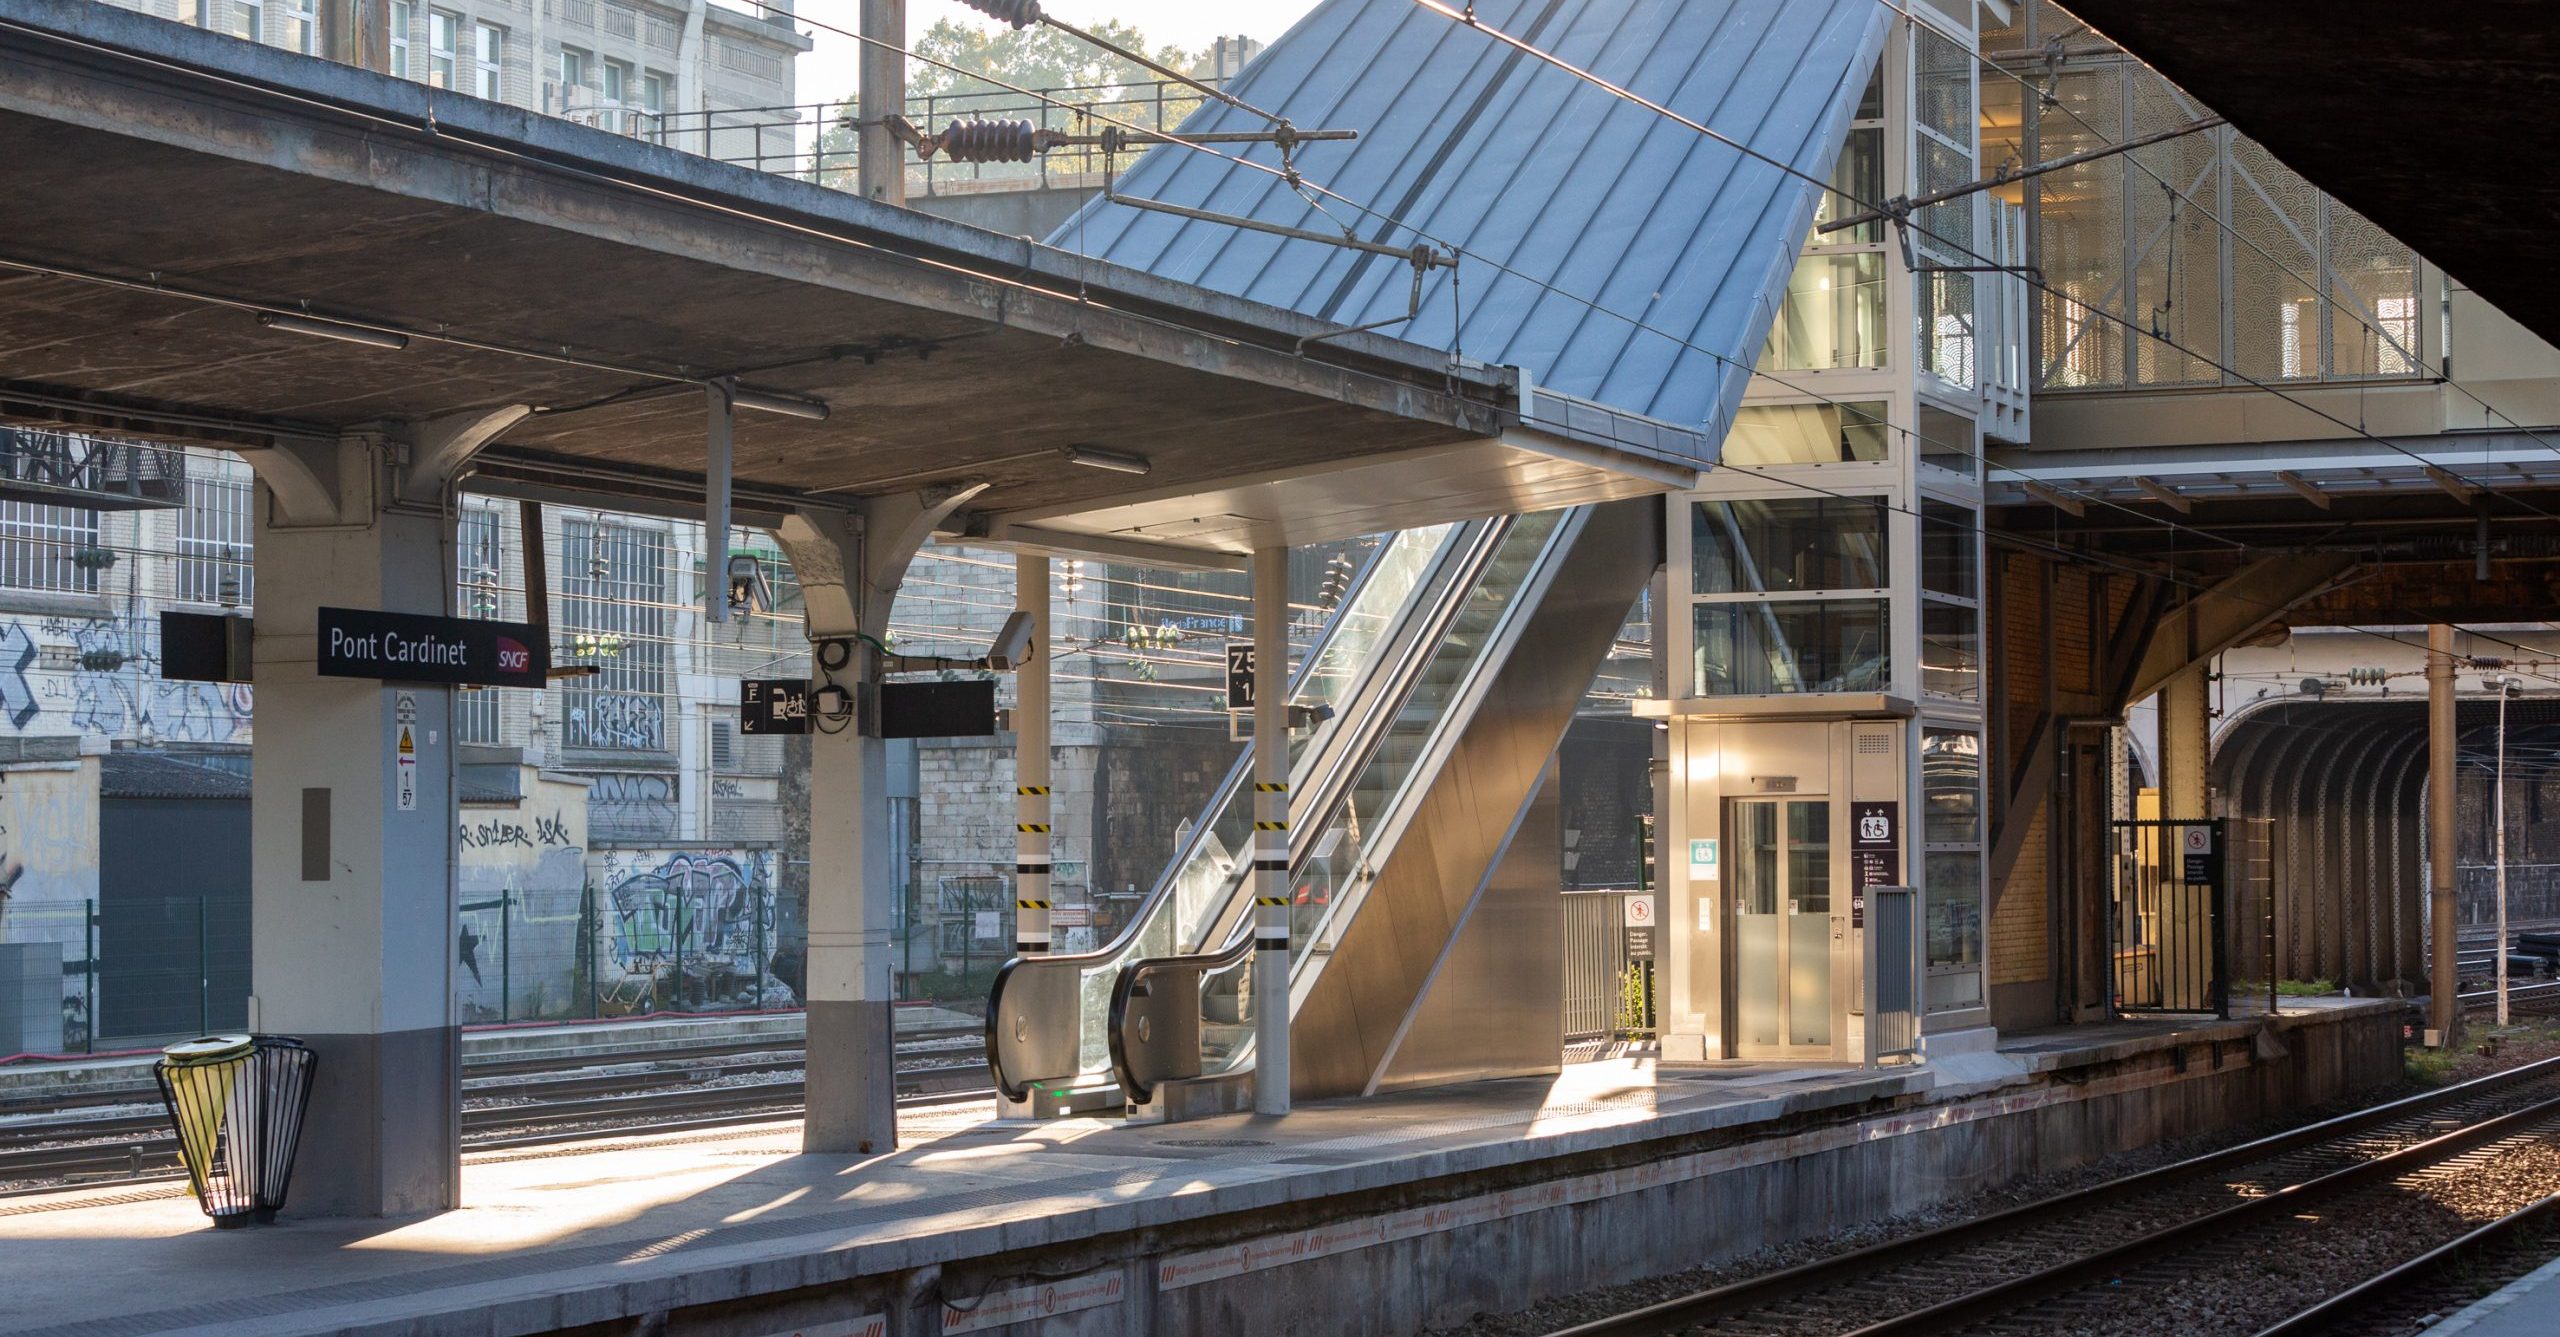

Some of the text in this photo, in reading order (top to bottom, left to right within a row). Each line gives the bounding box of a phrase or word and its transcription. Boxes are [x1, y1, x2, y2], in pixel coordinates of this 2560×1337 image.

[331, 628, 467, 665] Pont Cardinet
[499, 650, 528, 668] SNCF
[749, 689, 757, 700] F
[405, 770, 408, 787] 1
[402, 793, 412, 806] 57
